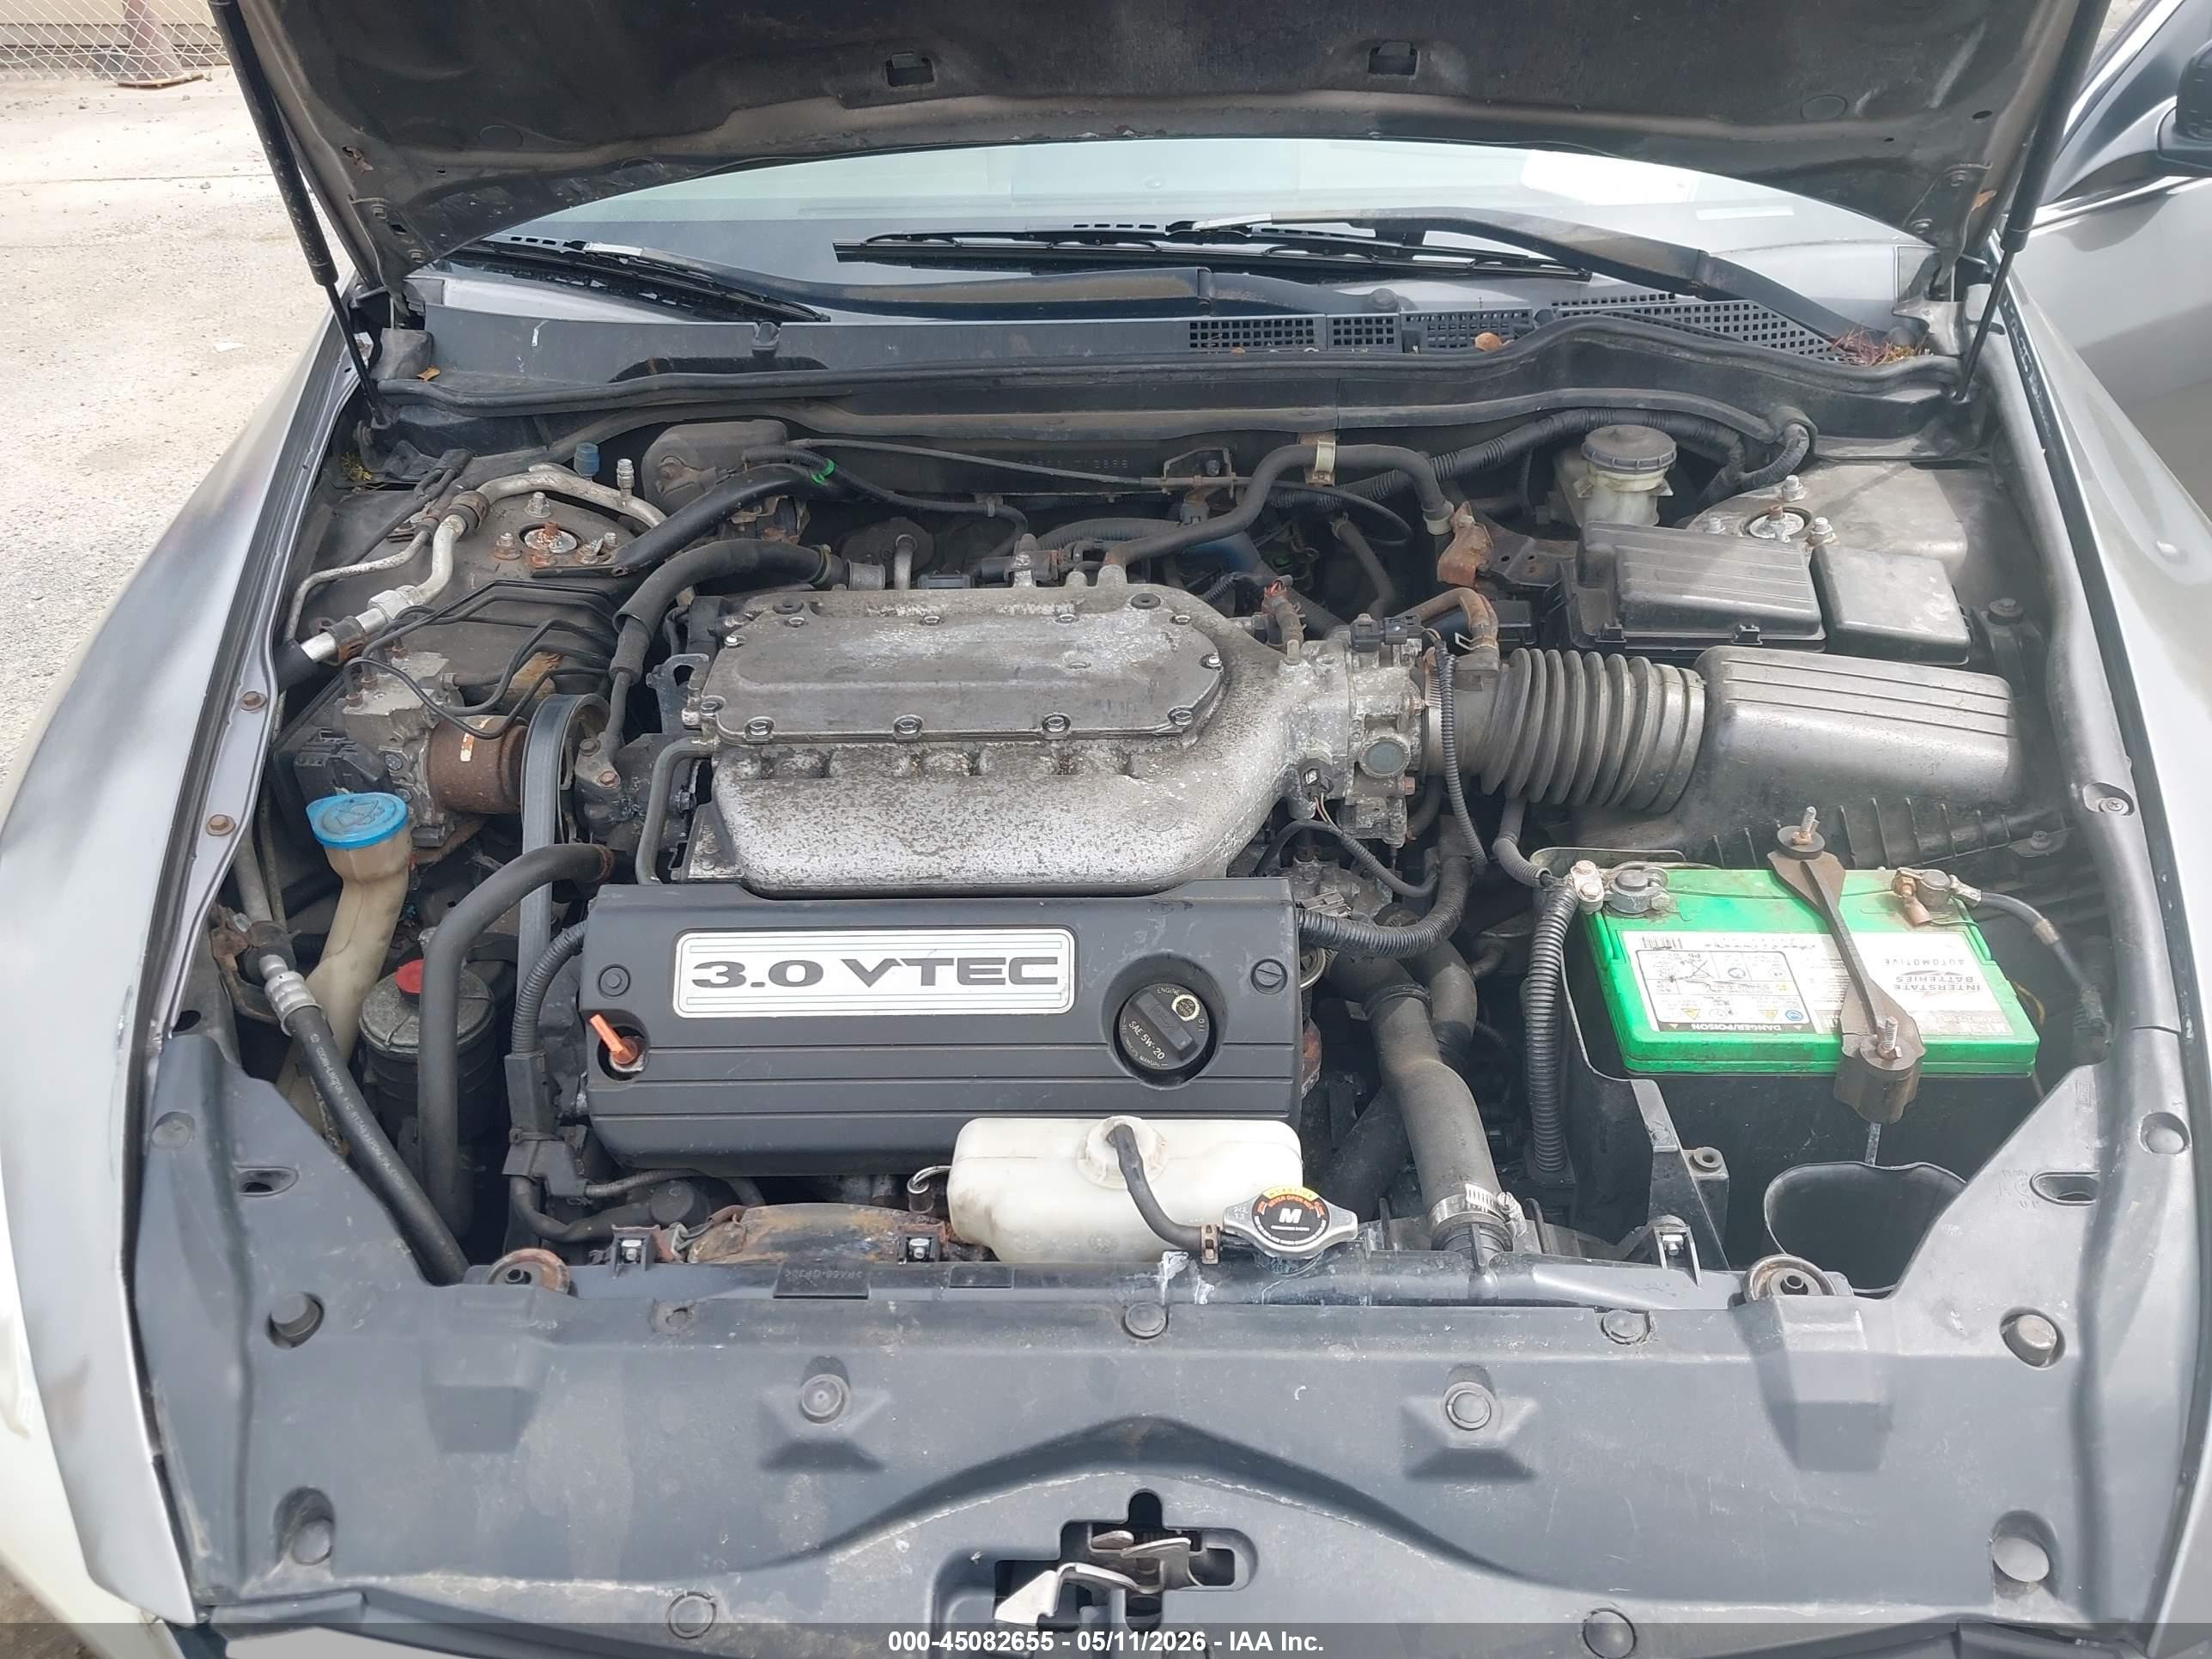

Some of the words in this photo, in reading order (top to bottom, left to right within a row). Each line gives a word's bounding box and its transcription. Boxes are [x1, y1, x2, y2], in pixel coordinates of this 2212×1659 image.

[692, 959, 824, 988] 3.0
[840, 955, 1058, 988] VTEC
[1157, 987, 1181, 996] ENGINE
[1128, 1020, 1144, 1036] SAE
[1140, 1033, 1165, 1060] 5W-20
[1279, 1207, 1303, 1224] M
